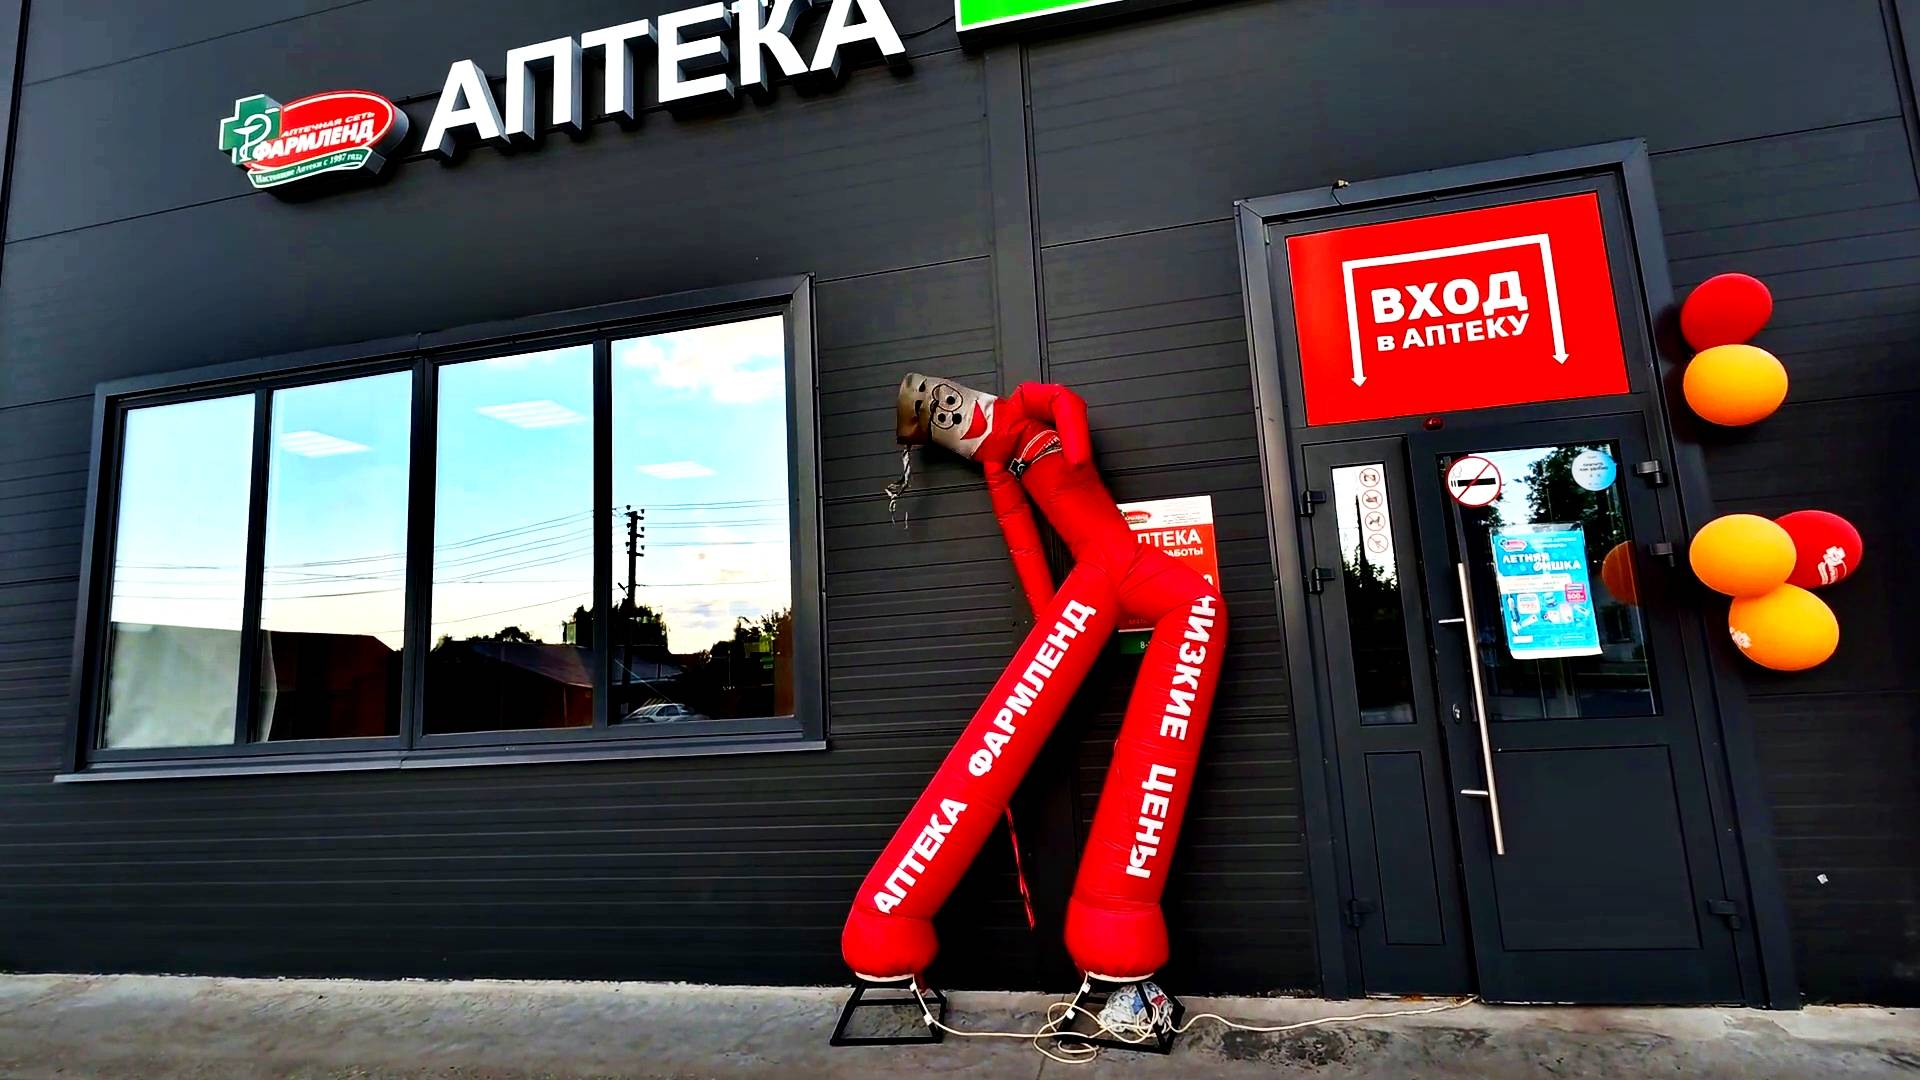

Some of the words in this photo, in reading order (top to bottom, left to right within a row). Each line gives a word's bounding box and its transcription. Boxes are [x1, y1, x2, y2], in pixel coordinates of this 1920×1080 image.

[421, 0, 906, 152] АПТЕКА
[252, 119, 376, 161] ФАРМЛЕНД
[281, 117, 343, 137] АПТЕЧНАЯ
[344, 111, 376, 124] СЕТЬ
[1370, 270, 1529, 324] ВХОД
[1376, 335, 1396, 352] в
[1402, 313, 1531, 349] АПТЕКУ
[1137, 529, 1202, 547] ПТЕКА
[1163, 547, 1204, 557] АБОТЫ
[1160, 595, 1217, 741] НИЗКИЕ
[873, 798, 968, 914] АПТЕКА
[968, 599, 1097, 777] ФАРМЛЕНД
[1125, 764, 1177, 879] ЦЕНЫ
